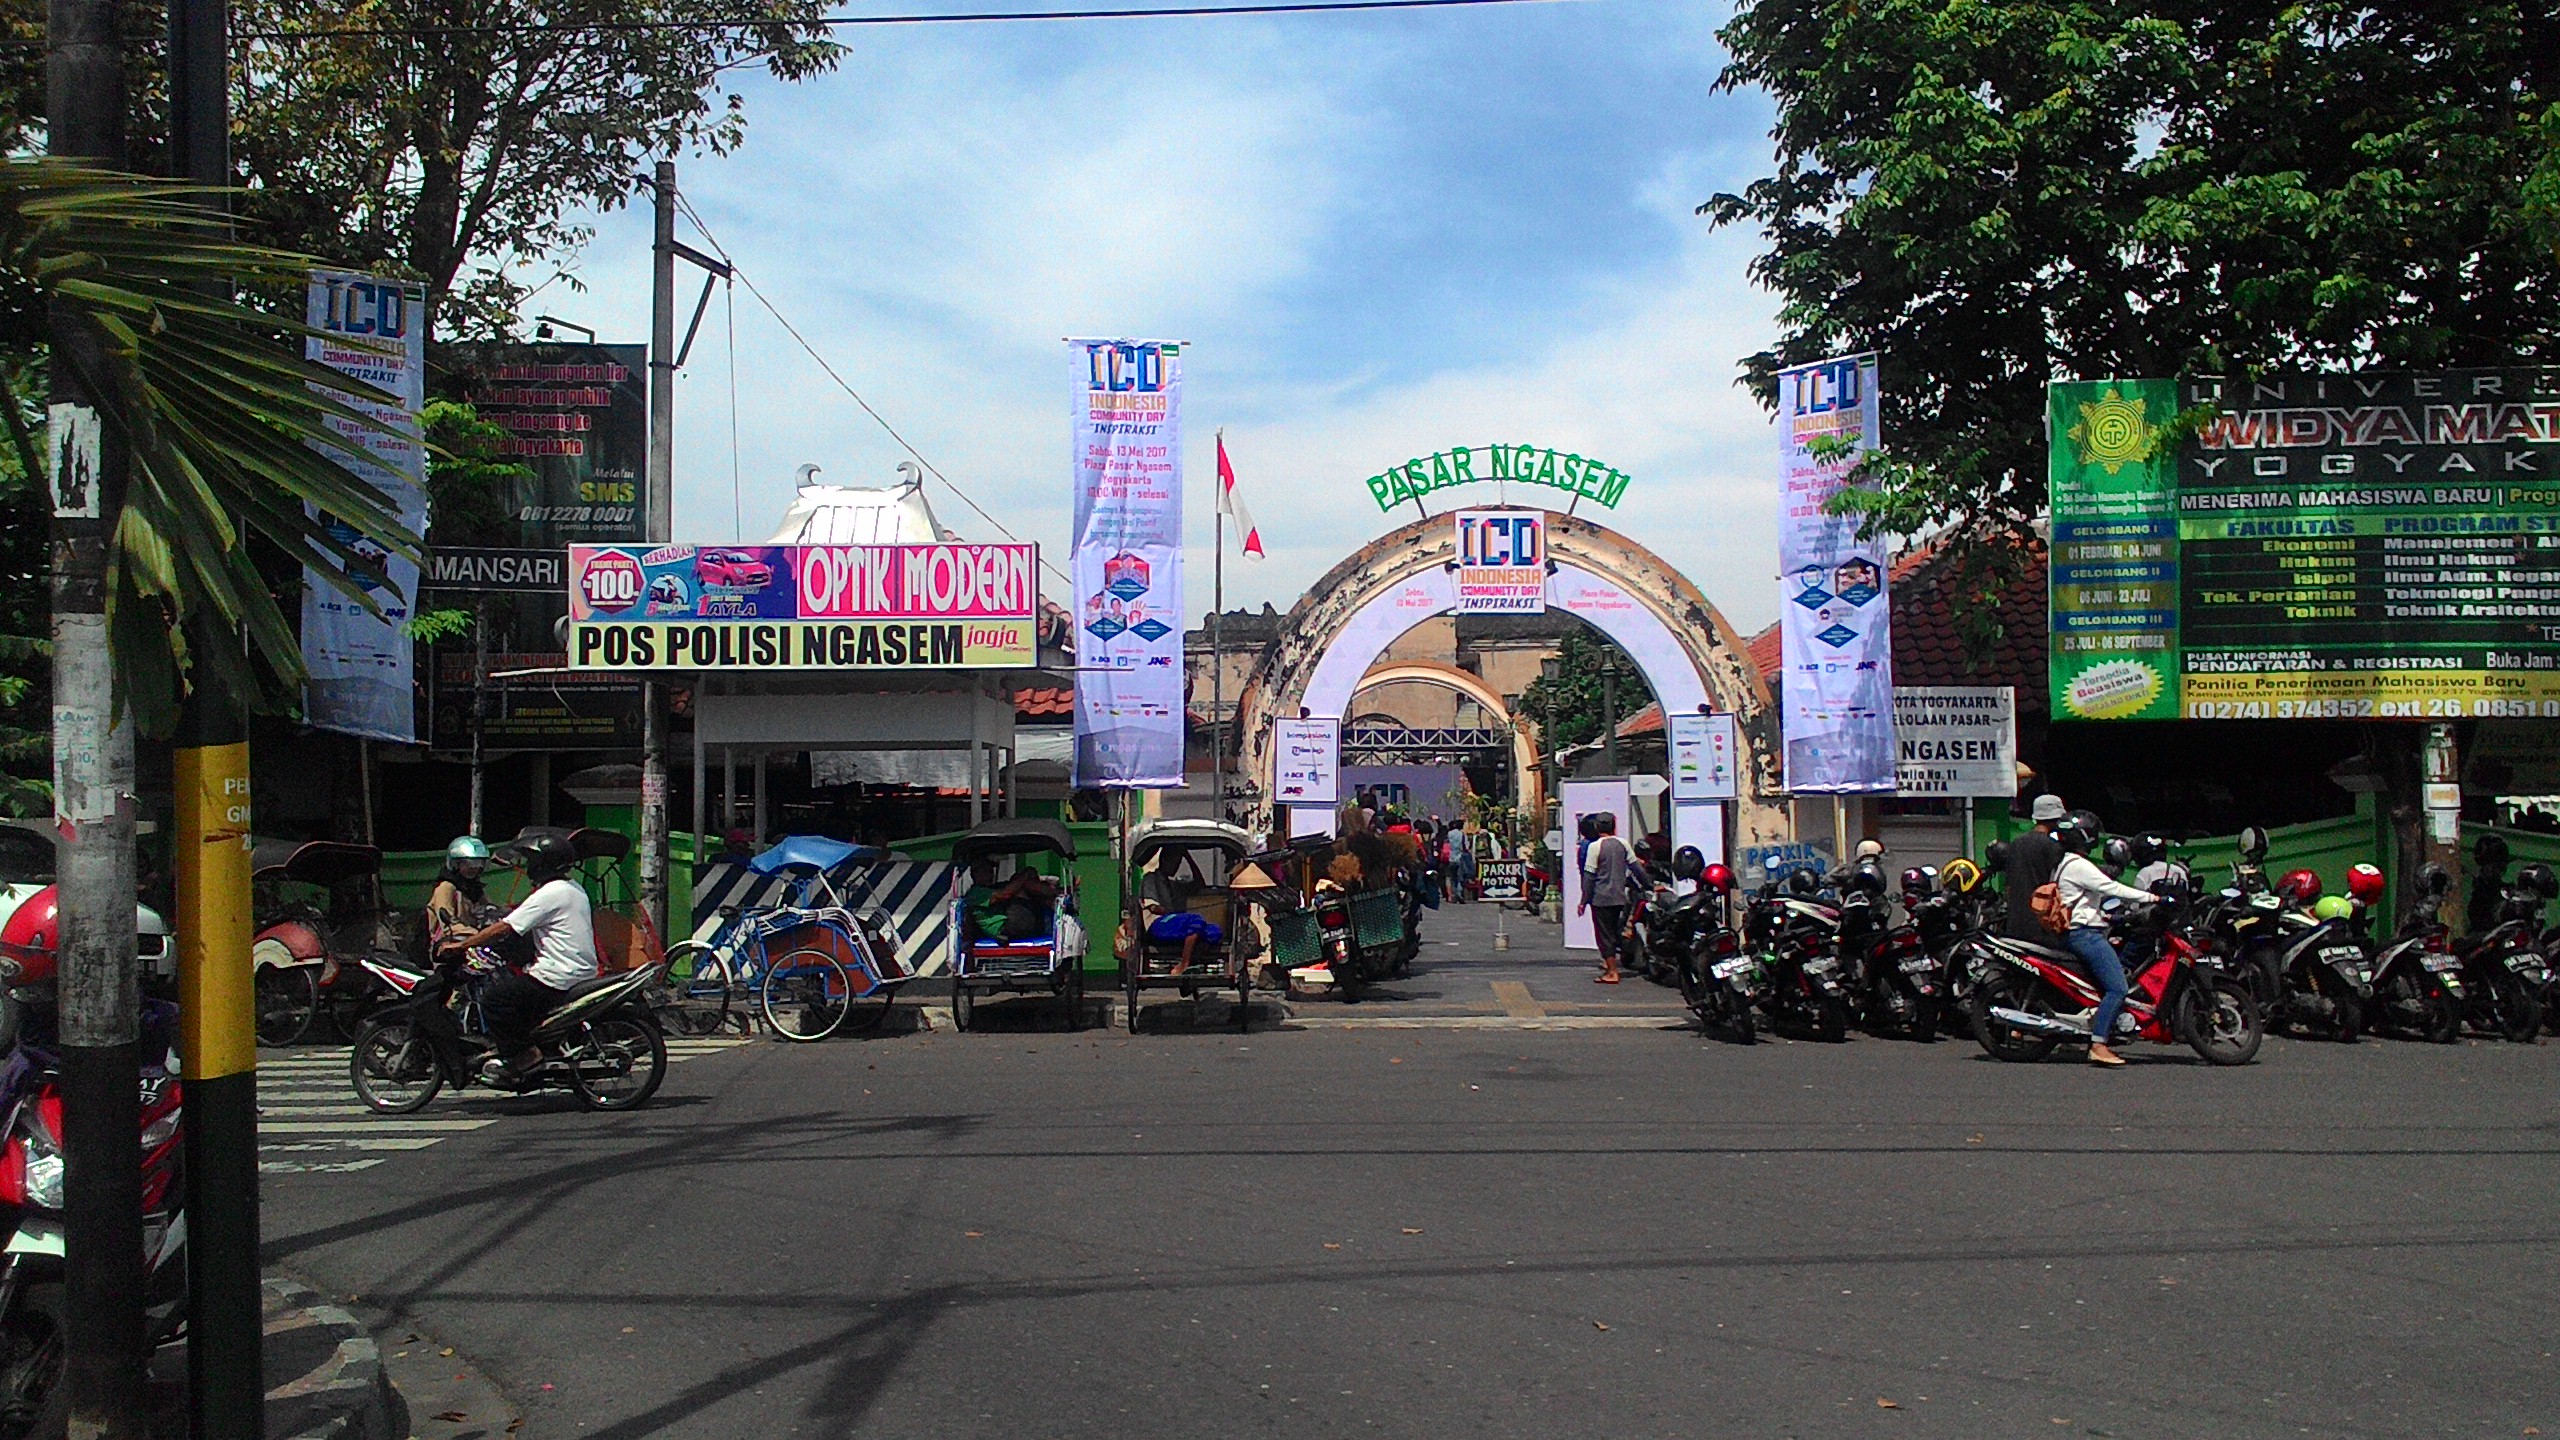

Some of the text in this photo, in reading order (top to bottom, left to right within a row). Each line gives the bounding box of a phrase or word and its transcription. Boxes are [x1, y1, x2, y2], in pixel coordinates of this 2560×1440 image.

[1087, 344, 1167, 393] ICD
[1793, 361, 1864, 416] ICD
[1088, 393, 1167, 411] INDONESIA
[574, 413, 592, 431] ke
[1090, 410, 1165, 422] COMMUNITY DAY
[1793, 410, 1863, 434] INDONESIA
[2197, 404, 2423, 449] WIDYA
[1117, 446, 1127, 456] 13
[1129, 446, 1144, 458] Mei
[1146, 446, 1167, 458] 2017
[1084, 459, 1172, 473] Plaza Pasar Ngasem
[1101, 473, 1152, 486] Yogyakarta
[1366, 443, 1631, 513] PASAR NGASEM
[580, 482, 636, 502] SMS
[2181, 492, 2292, 510] MENERIMA
[2298, 489, 2428, 506] MAHASISWA
[2434, 488, 2491, 504] BARU
[592, 506, 635, 522] 0001
[2072, 525, 2150, 537] GELOMBANG
[2227, 518, 2355, 536] FAKULTAS
[2384, 516, 2519, 533] PROGRAM
[1459, 517, 1541, 567] ICD
[2262, 539, 2356, 552] Ekonomi
[2080, 545, 2123, 559] FEBRUARI
[2142, 543, 2162, 557] JUNI
[2279, 556, 2356, 568] Hukum
[2384, 555, 2434, 567] Ilmu
[803, 546, 1031, 615] OPTIK MODERN
[1459, 568, 1541, 585] INDONESIA
[2070, 567, 2148, 578] GELOMBANG
[2293, 572, 2356, 585] Isipol
[2384, 571, 2434, 584] Ilmu
[2438, 570, 2495, 583] Adm.
[1461, 586, 1541, 596] COMMUNITY DAY
[2202, 589, 2356, 604] Tek. Pertanian
[2384, 587, 2493, 602] Teknologi
[707, 602, 757, 616] AYLA
[2284, 606, 2357, 618] Teknik
[2384, 604, 2458, 617] Teknik
[2068, 615, 2147, 626] GELOMBANG
[964, 624, 1019, 649] jogja
[2076, 636, 2096, 650] JULI
[2114, 634, 2165, 649] SEPTEMBER
[578, 623, 964, 667] POS POLISI NGASEM
[2187, 651, 2312, 661] PUSAT INFORMASI
[2187, 656, 2463, 672] PENDAFTARAN & REGISTRASI
[2486, 652, 2554, 669] Buka Jam
[2076, 673, 2144, 698] Beasiswa
[2187, 675, 2526, 690] Panitia Penerimaan Mahasiswa Baru
[1893, 695, 1998, 709] OTA YOGYAKARTA
[2187, 698, 2537, 719] (0274) 374352 ext 26. 0851
[1950, 714, 1991, 726] PASAR
[1902, 740, 1997, 760] NGASEM
[1747, 843, 1815, 865] PARKIR
[1483, 862, 1523, 876] PARKIR
[1482, 876, 1518, 886] MOTOR
[1993, 947, 2041, 976] HONDA
